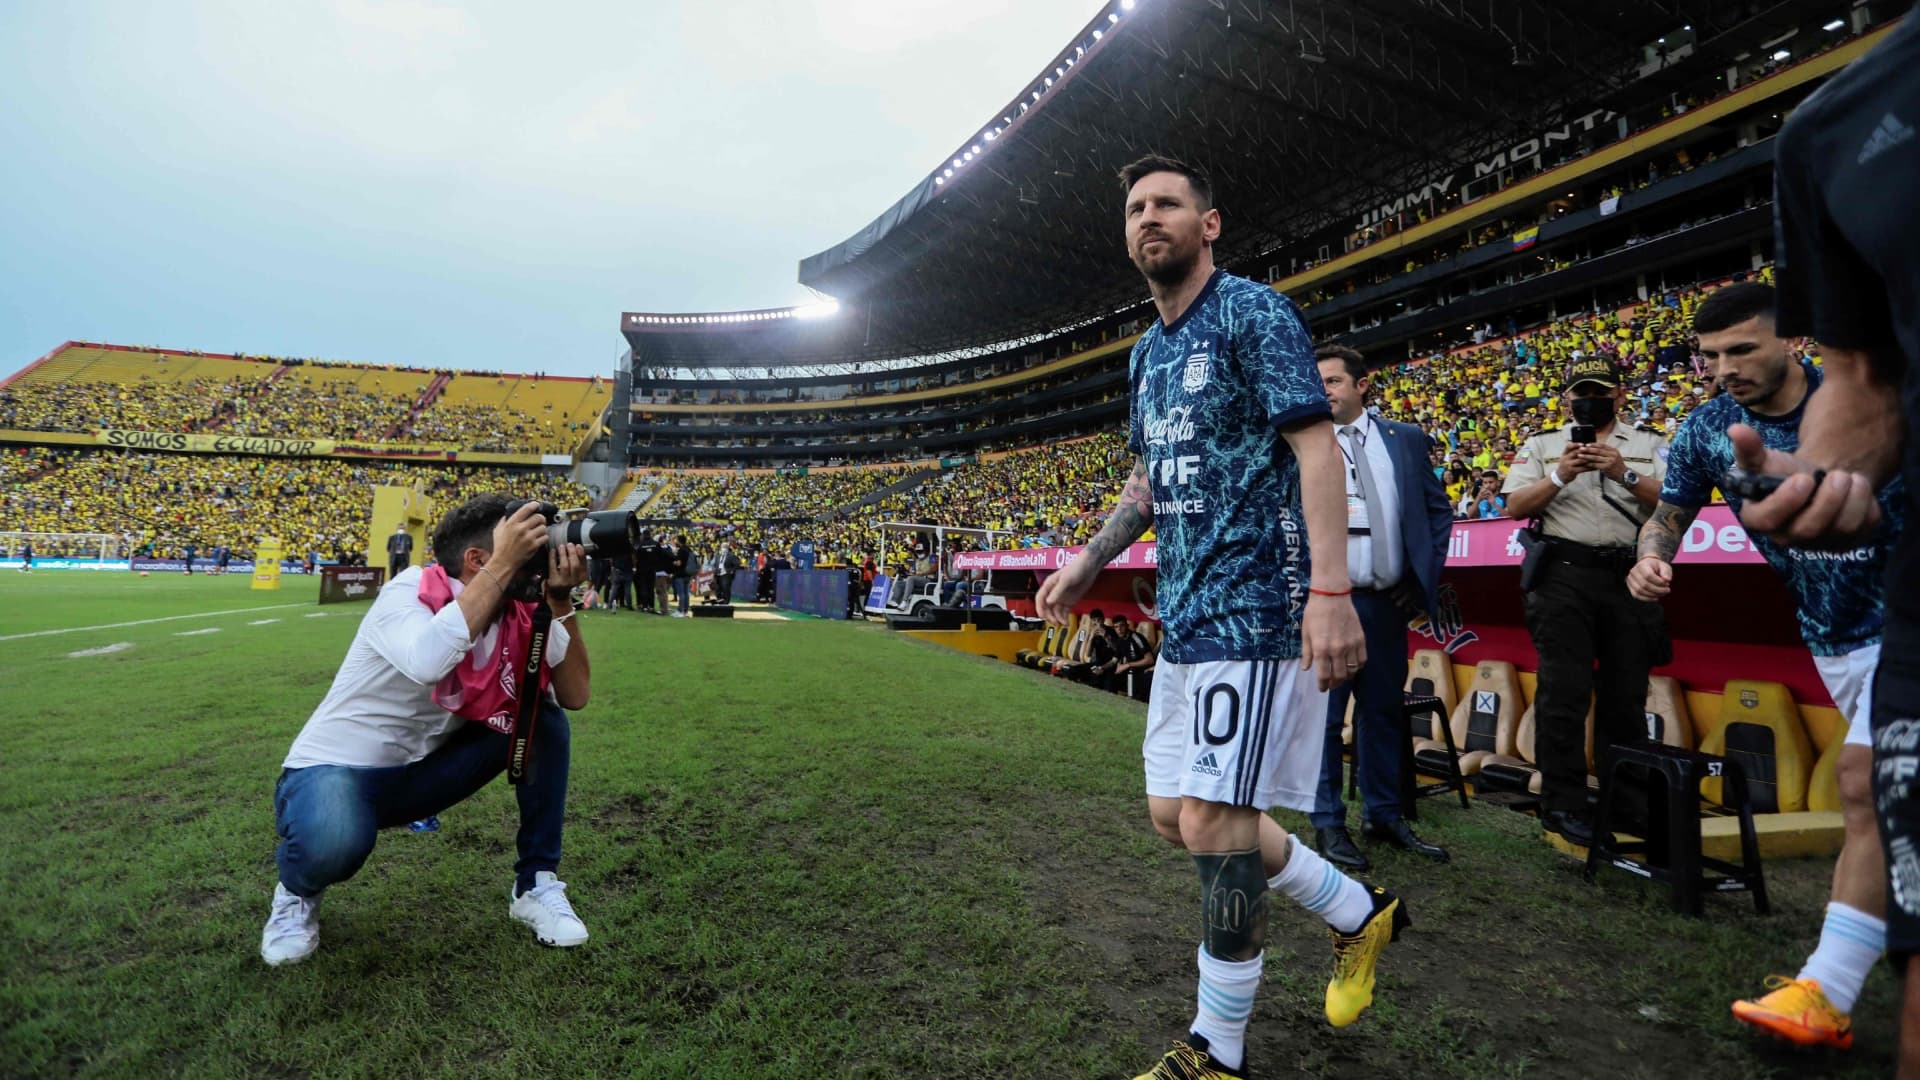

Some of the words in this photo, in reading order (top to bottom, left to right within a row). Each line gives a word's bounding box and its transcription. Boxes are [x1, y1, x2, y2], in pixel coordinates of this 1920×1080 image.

[1355, 174, 1454, 230] JIMMY
[107, 430, 187, 450] SOMOS
[213, 436, 316, 455] ECUADOR
[1153, 499, 1205, 515] BINANCE
[134, 561, 215, 571] marathon.cm.ec
[1279, 502, 1304, 614] RGENTINA
[527, 632, 544, 674] Canon
[1193, 682, 1240, 746] 10
[511, 737, 527, 778] Canon
[1191, 764, 1222, 777] adidas
[1707, 762, 1723, 777] 57
[1210, 887, 1249, 934] 10
